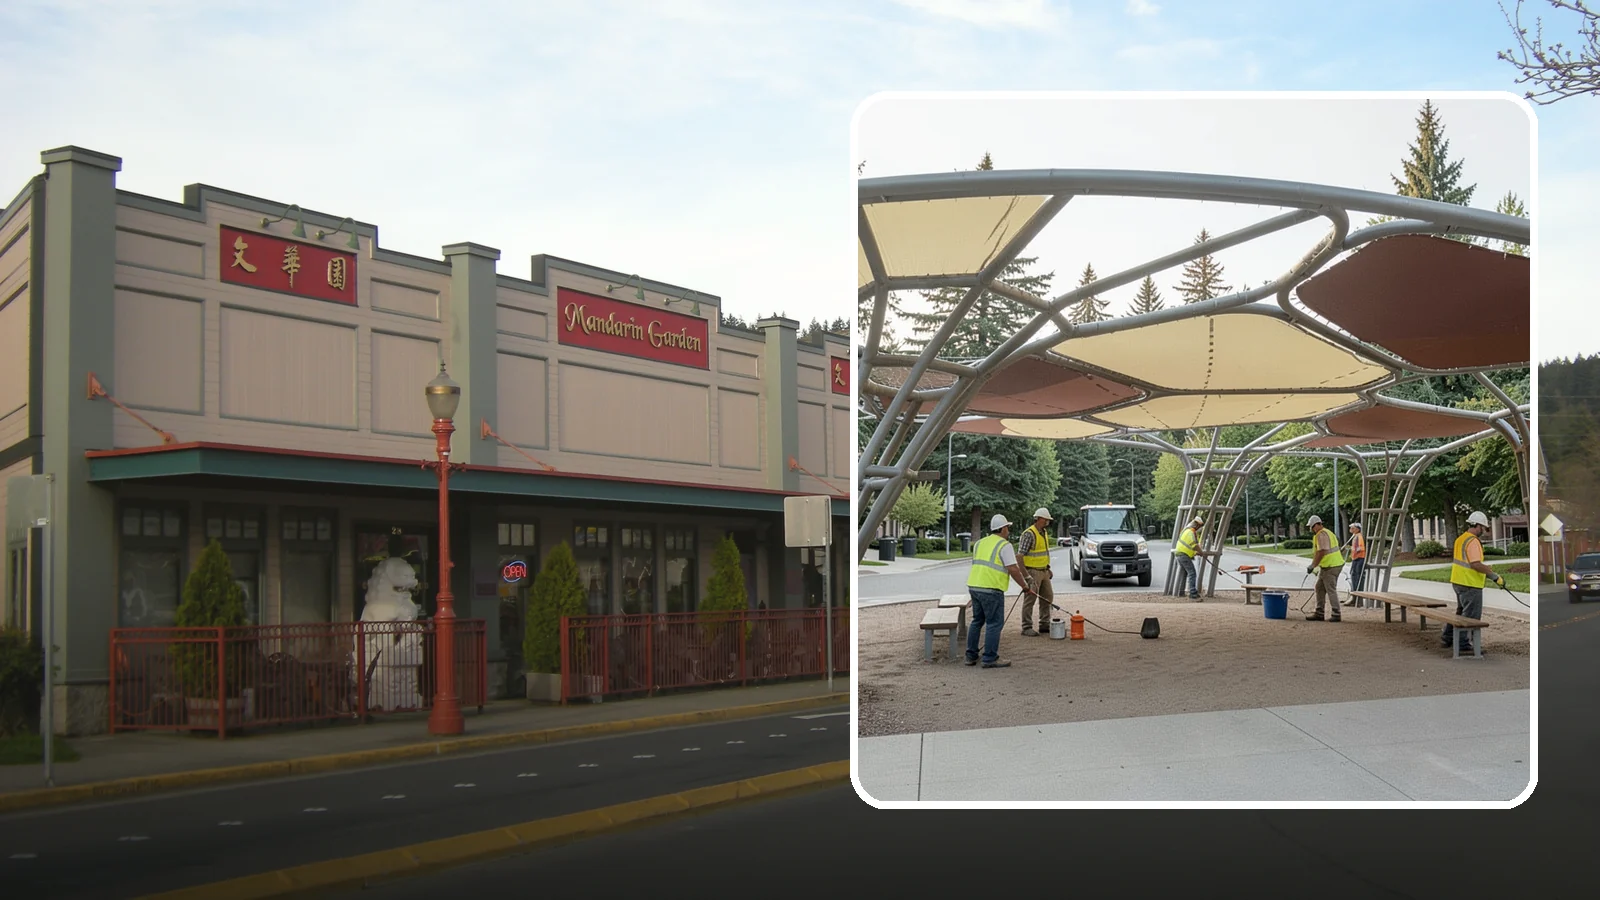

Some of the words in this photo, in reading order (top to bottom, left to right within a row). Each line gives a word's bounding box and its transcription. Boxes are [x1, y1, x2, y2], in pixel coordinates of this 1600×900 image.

[564, 302, 644, 341] Mandarin
[648, 320, 702, 352] Garden
[503, 565, 527, 578] OPEN
